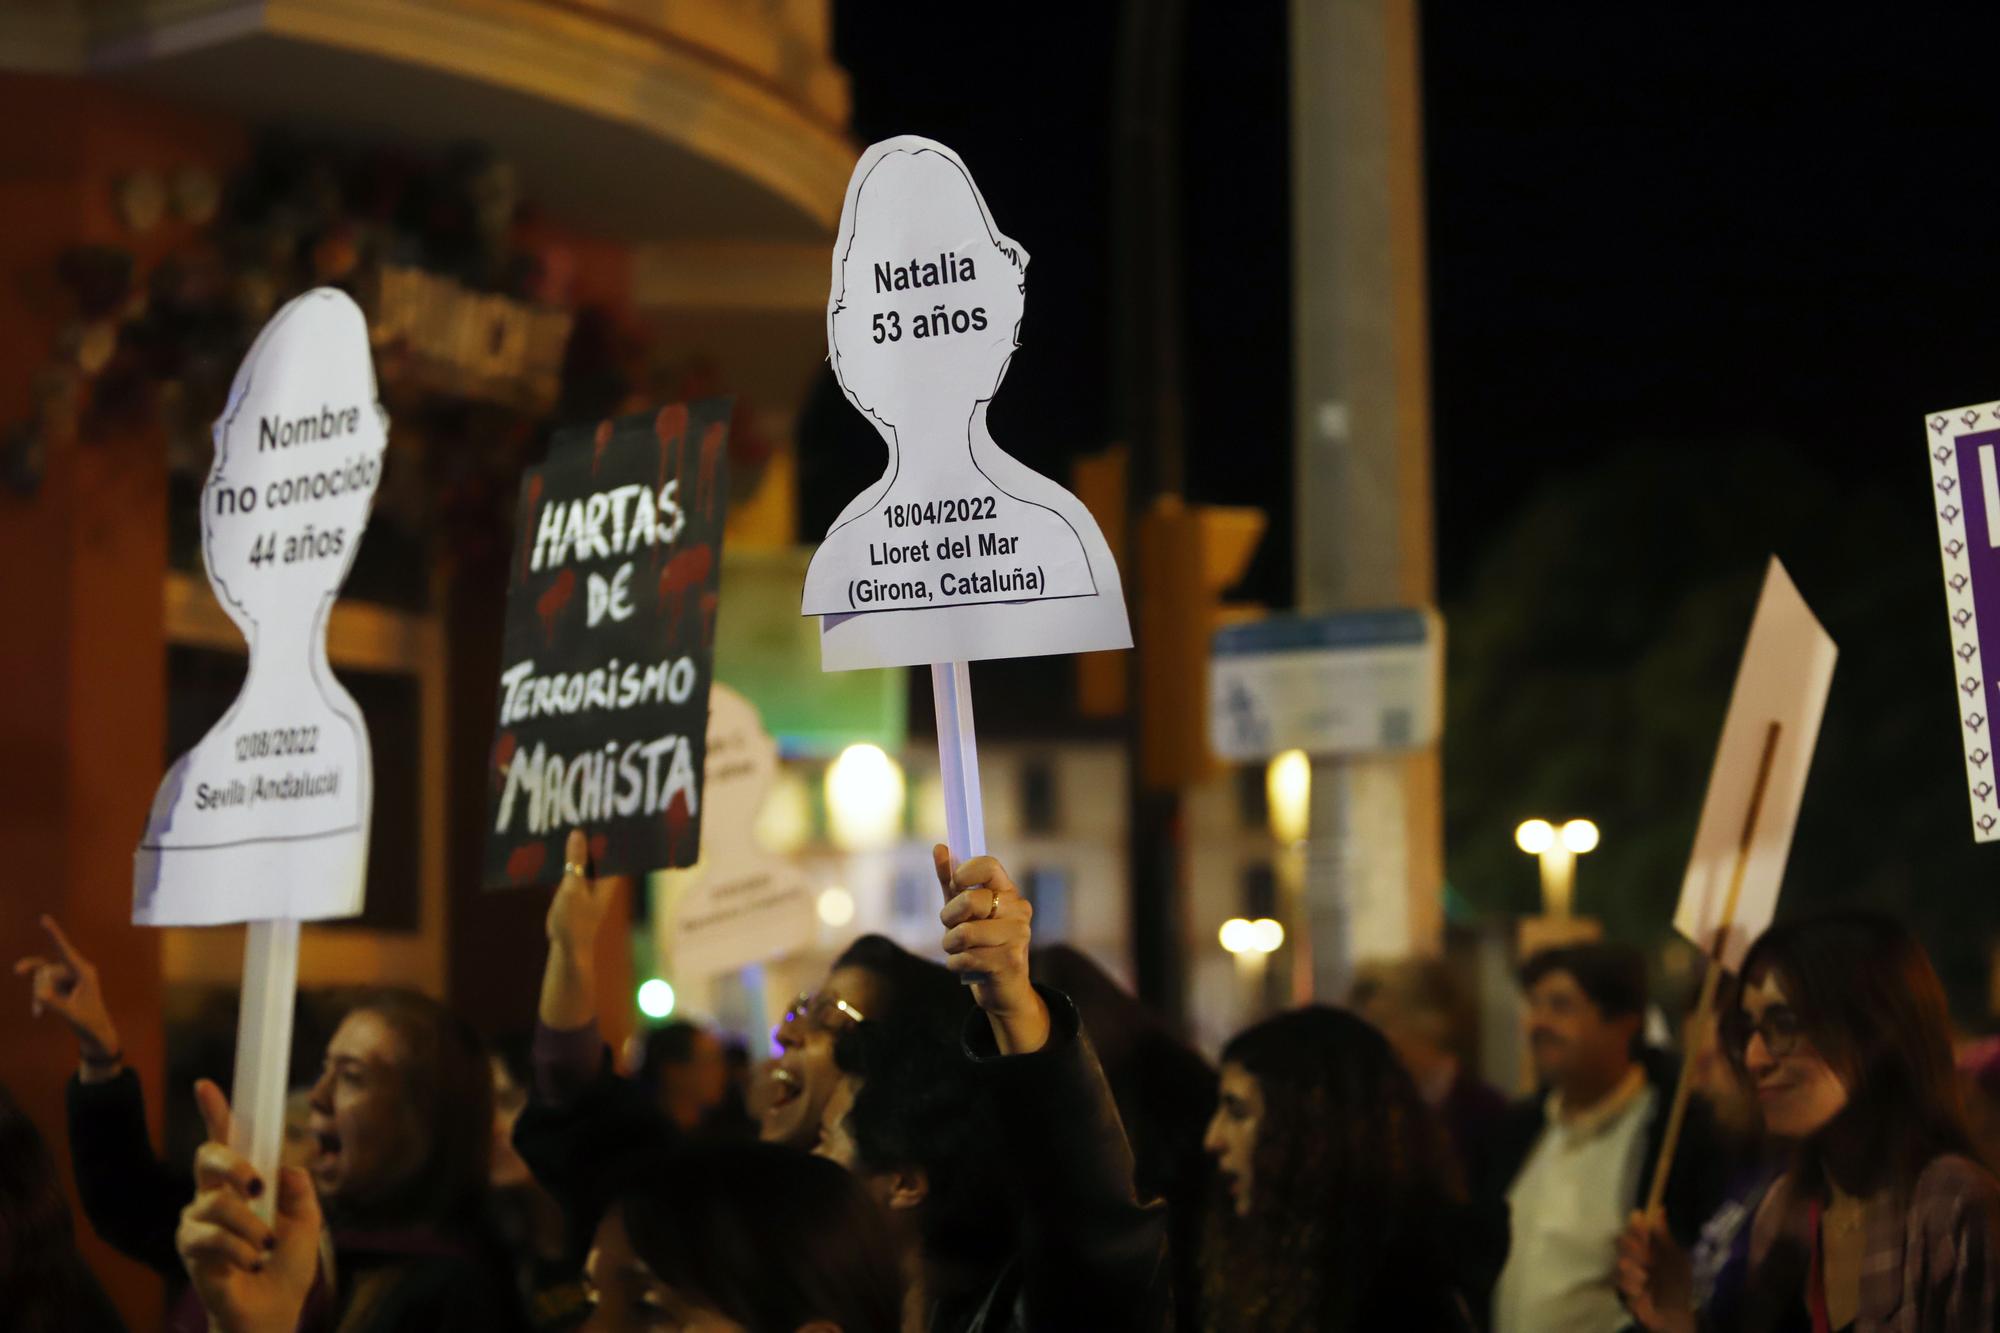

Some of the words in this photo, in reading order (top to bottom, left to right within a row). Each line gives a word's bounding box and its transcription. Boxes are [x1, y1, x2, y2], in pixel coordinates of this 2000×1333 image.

[874, 251, 976, 294] Natalia
[872, 310, 902, 344] 53
[912, 304, 988, 339] años
[258, 404, 360, 453] Nombre
[216, 486, 257, 516] no
[265, 453, 376, 509] conocido
[530, 479, 685, 572] HARTAS
[883, 496, 998, 528] 18/04/2022
[249, 531, 277, 570] 44
[283, 524, 345, 564] años
[869, 539, 930, 566] Lloret
[936, 535, 971, 561] del
[978, 532, 1020, 557] Mar
[586, 562, 635, 628] DE
[848, 579, 934, 609] (Girona,
[939, 565, 1046, 597] Cataluña)
